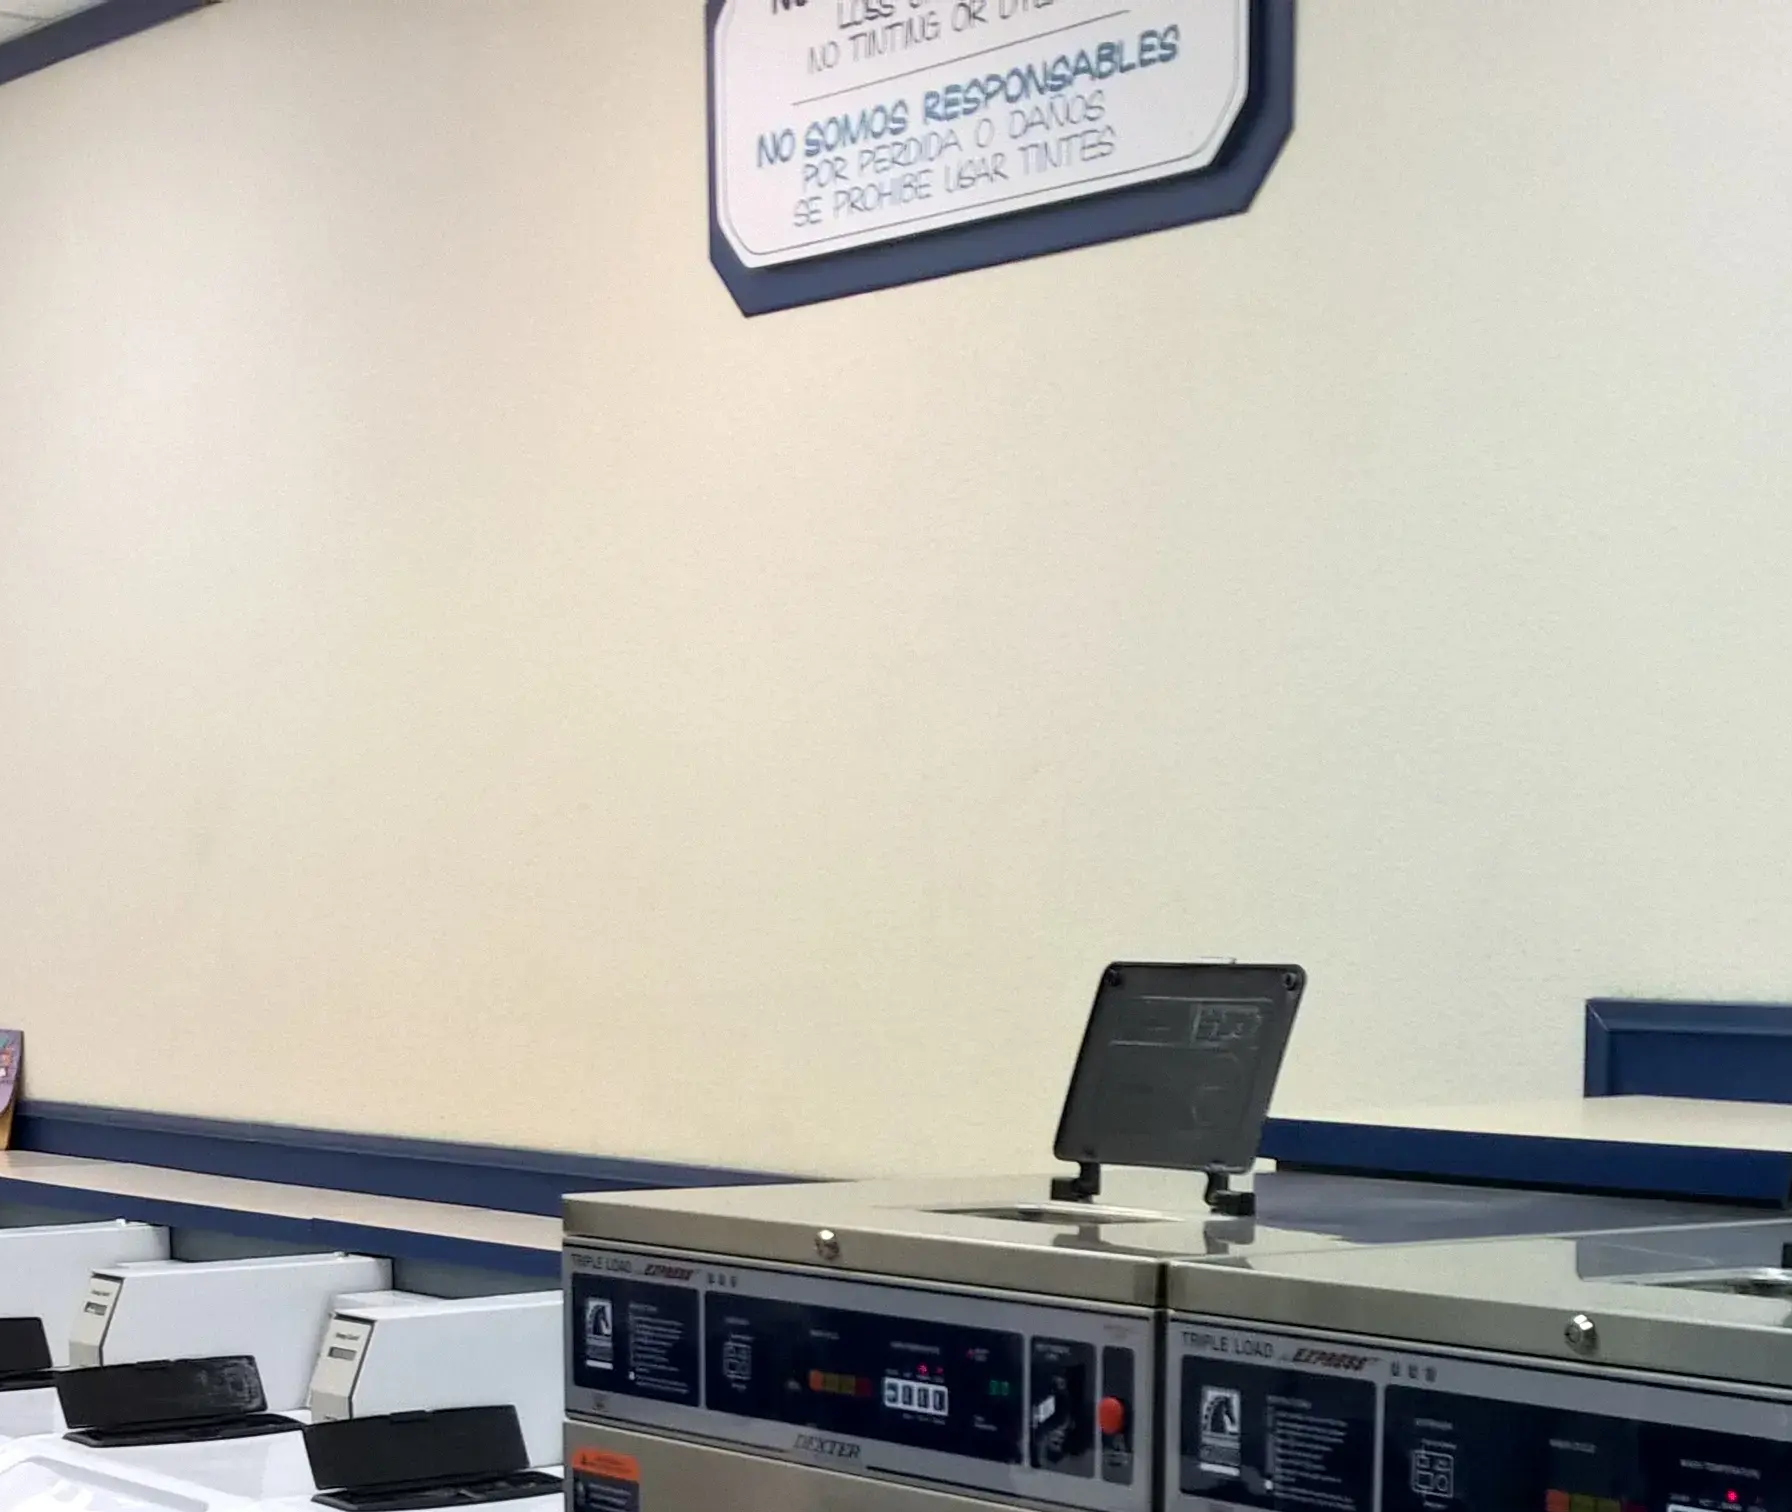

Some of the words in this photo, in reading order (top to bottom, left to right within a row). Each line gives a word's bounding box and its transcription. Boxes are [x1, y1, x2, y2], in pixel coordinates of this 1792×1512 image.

[808, 41, 840, 74] NO
[848, 10, 941, 61] TINTING
[951, 0, 988, 31] OR
[757, 130, 795, 168] NO
[804, 99, 908, 158] SOMOS
[923, 24, 1181, 125] RESPONSABLES
[803, 157, 848, 191] POR
[858, 131, 962, 174] PERDIDA
[973, 117, 995, 147] O
[1010, 88, 1105, 139] DAÑOS
[793, 197, 823, 228] SE
[833, 167, 932, 219] PROHIBE
[945, 152, 1009, 193] USAR
[1019, 125, 1116, 175] TINTES
[1181, 1331, 1228, 1351] TRIPLE
[1235, 1338, 1273, 1358] LOAD
[793, 1434, 861, 1458] DEXTER
